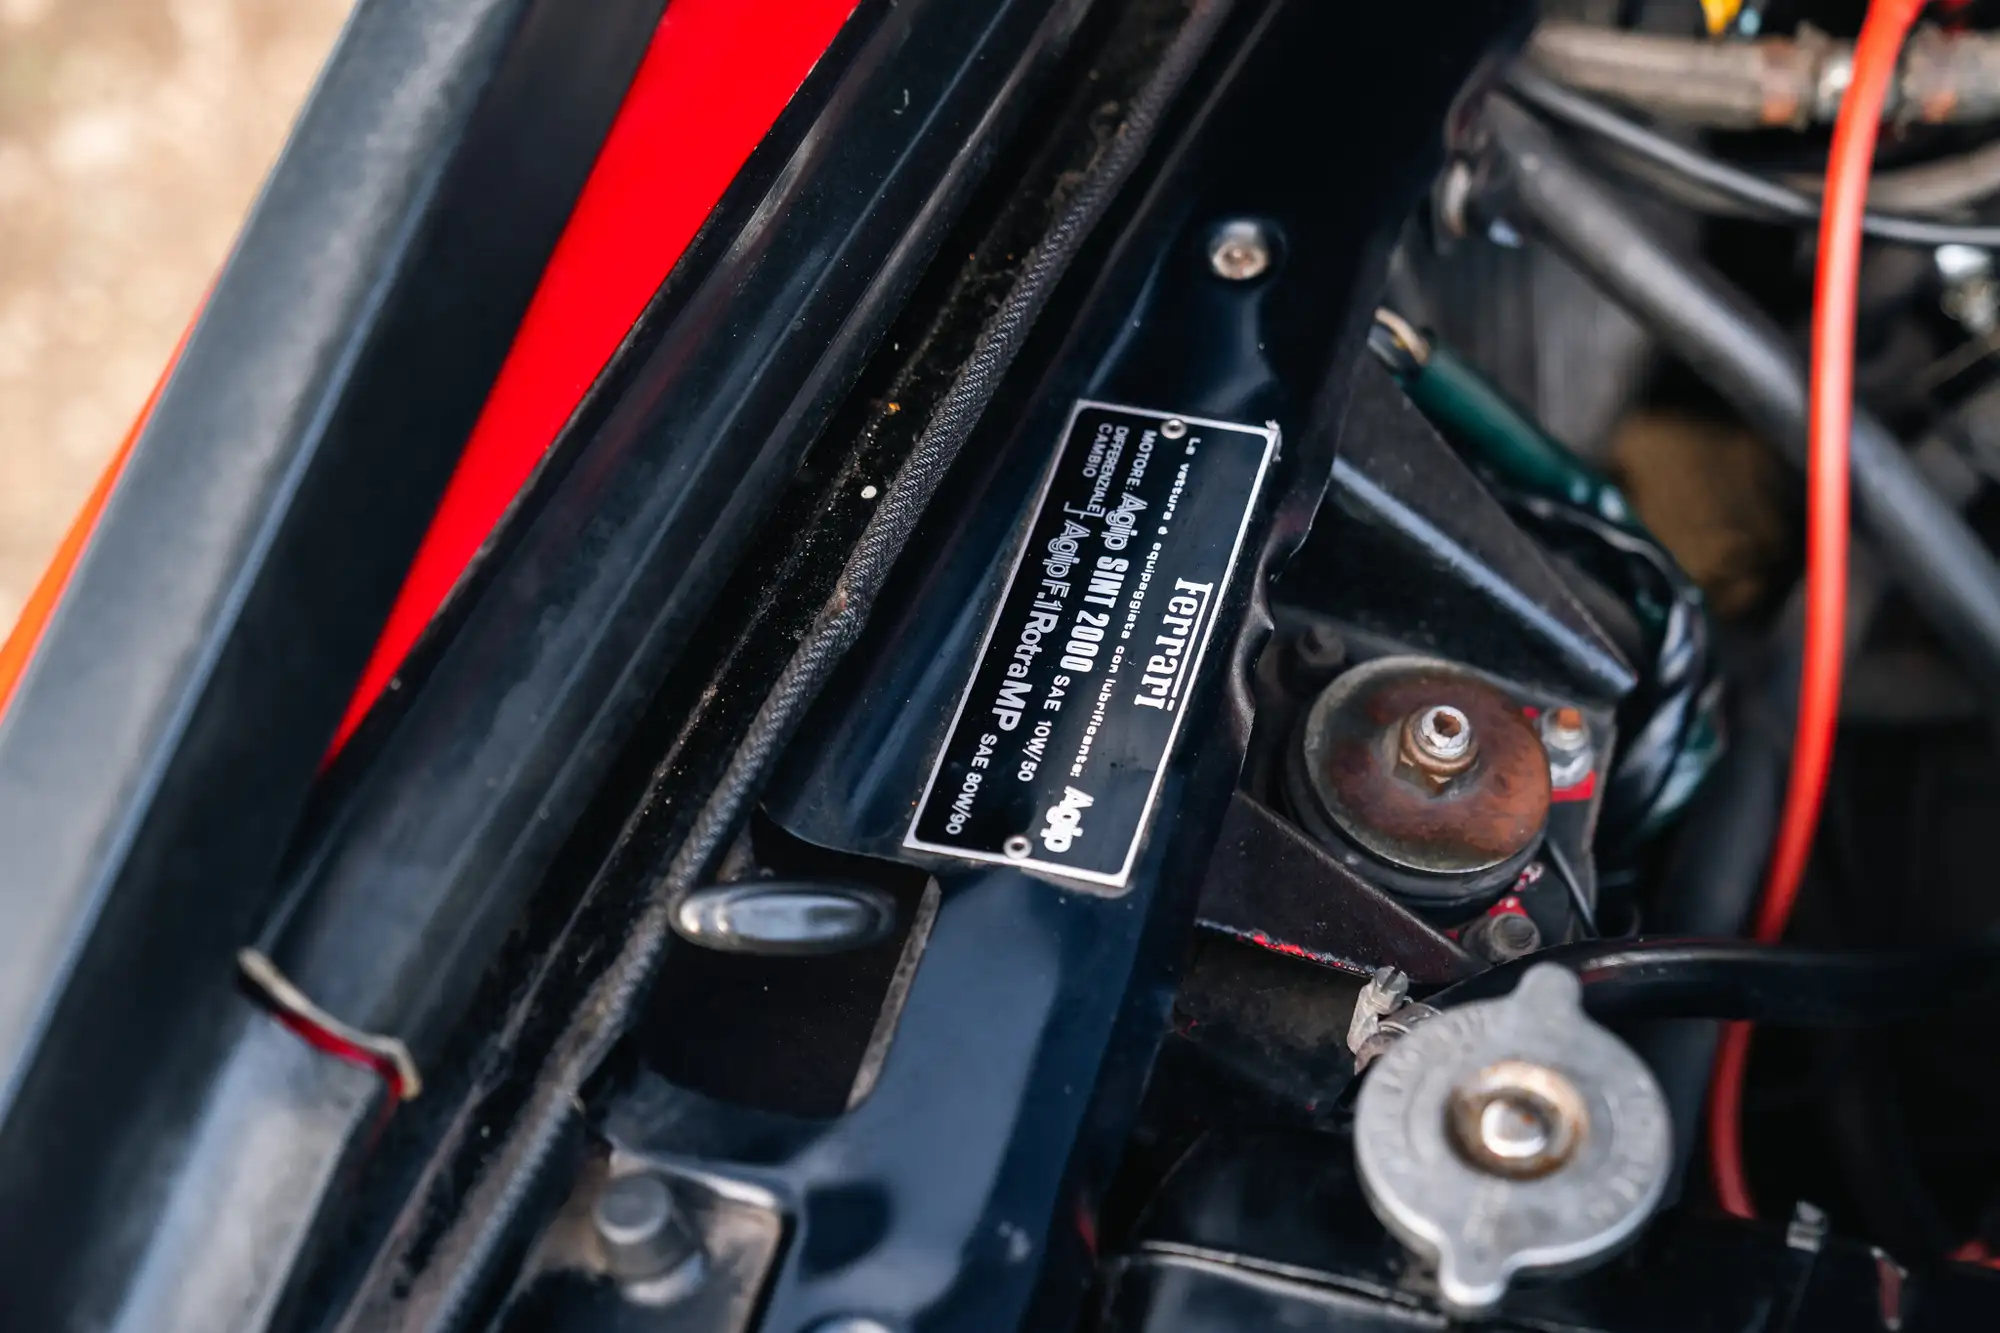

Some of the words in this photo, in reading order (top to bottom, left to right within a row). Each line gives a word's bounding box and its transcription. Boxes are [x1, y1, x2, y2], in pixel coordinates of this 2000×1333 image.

[1082, 423, 1113, 478] CAMBIO
[1086, 426, 1130, 513] DIFFERENZIALE
[1125, 430, 1158, 491] MOTORE:
[1185, 437, 1201, 456] La
[1100, 492, 1148, 551] Agip
[1162, 463, 1190, 521] vettura
[1042, 519, 1091, 578] Agip
[1083, 555, 1130, 609] SINT
[1120, 542, 1162, 640] equipaggiata
[1059, 610, 1110, 673] 2000
[1108, 645, 1125, 674] con
[1133, 577, 1214, 712] Ferrari
[1043, 674, 1071, 712] SAE
[970, 733, 998, 769] SAE
[1017, 720, 1053, 782] 10W/50
[1069, 678, 1117, 778] lubrificante:
[945, 772, 983, 835] 80W/90
[1039, 785, 1095, 853] Agip
